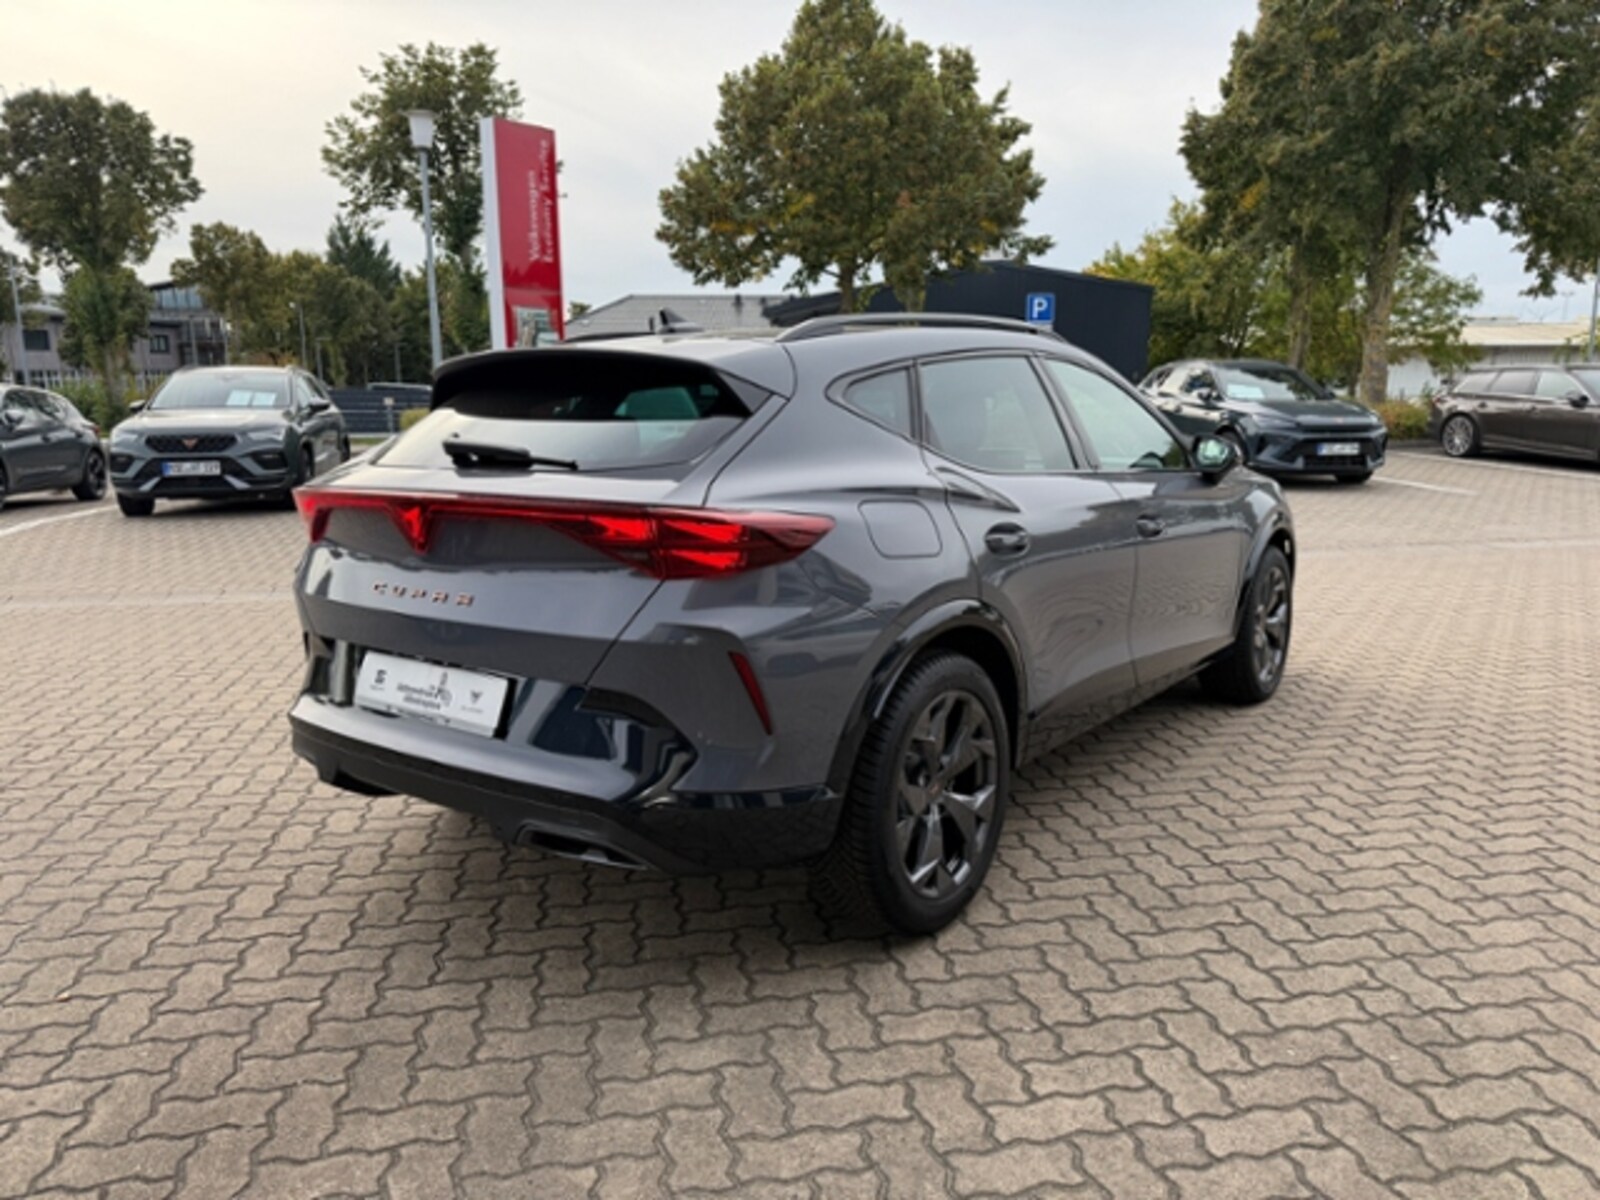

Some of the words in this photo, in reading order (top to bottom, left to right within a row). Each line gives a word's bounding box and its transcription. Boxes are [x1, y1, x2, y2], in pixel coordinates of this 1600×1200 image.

[539, 139, 549, 191] Service
[528, 170, 540, 261] Volkswagen
[541, 196, 553, 263] Economy
[1032, 297, 1048, 318] P
